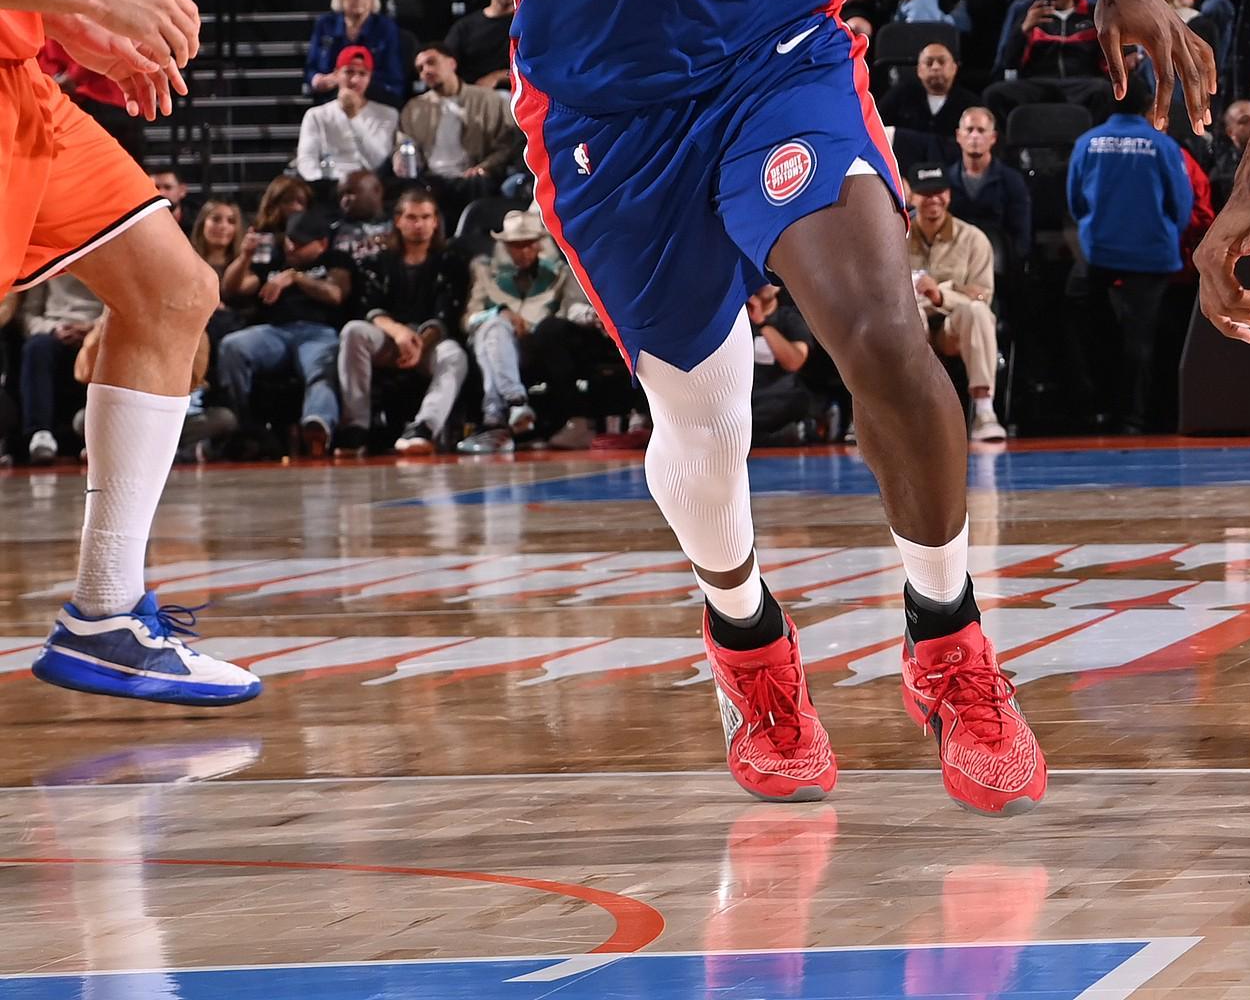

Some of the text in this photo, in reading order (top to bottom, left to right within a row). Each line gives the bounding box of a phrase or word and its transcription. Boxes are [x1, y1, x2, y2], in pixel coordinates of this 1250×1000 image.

[1089, 136, 1153, 148] SECURITY
[769, 154, 803, 179] DETROIT
[771, 165, 805, 190] PISTONS
